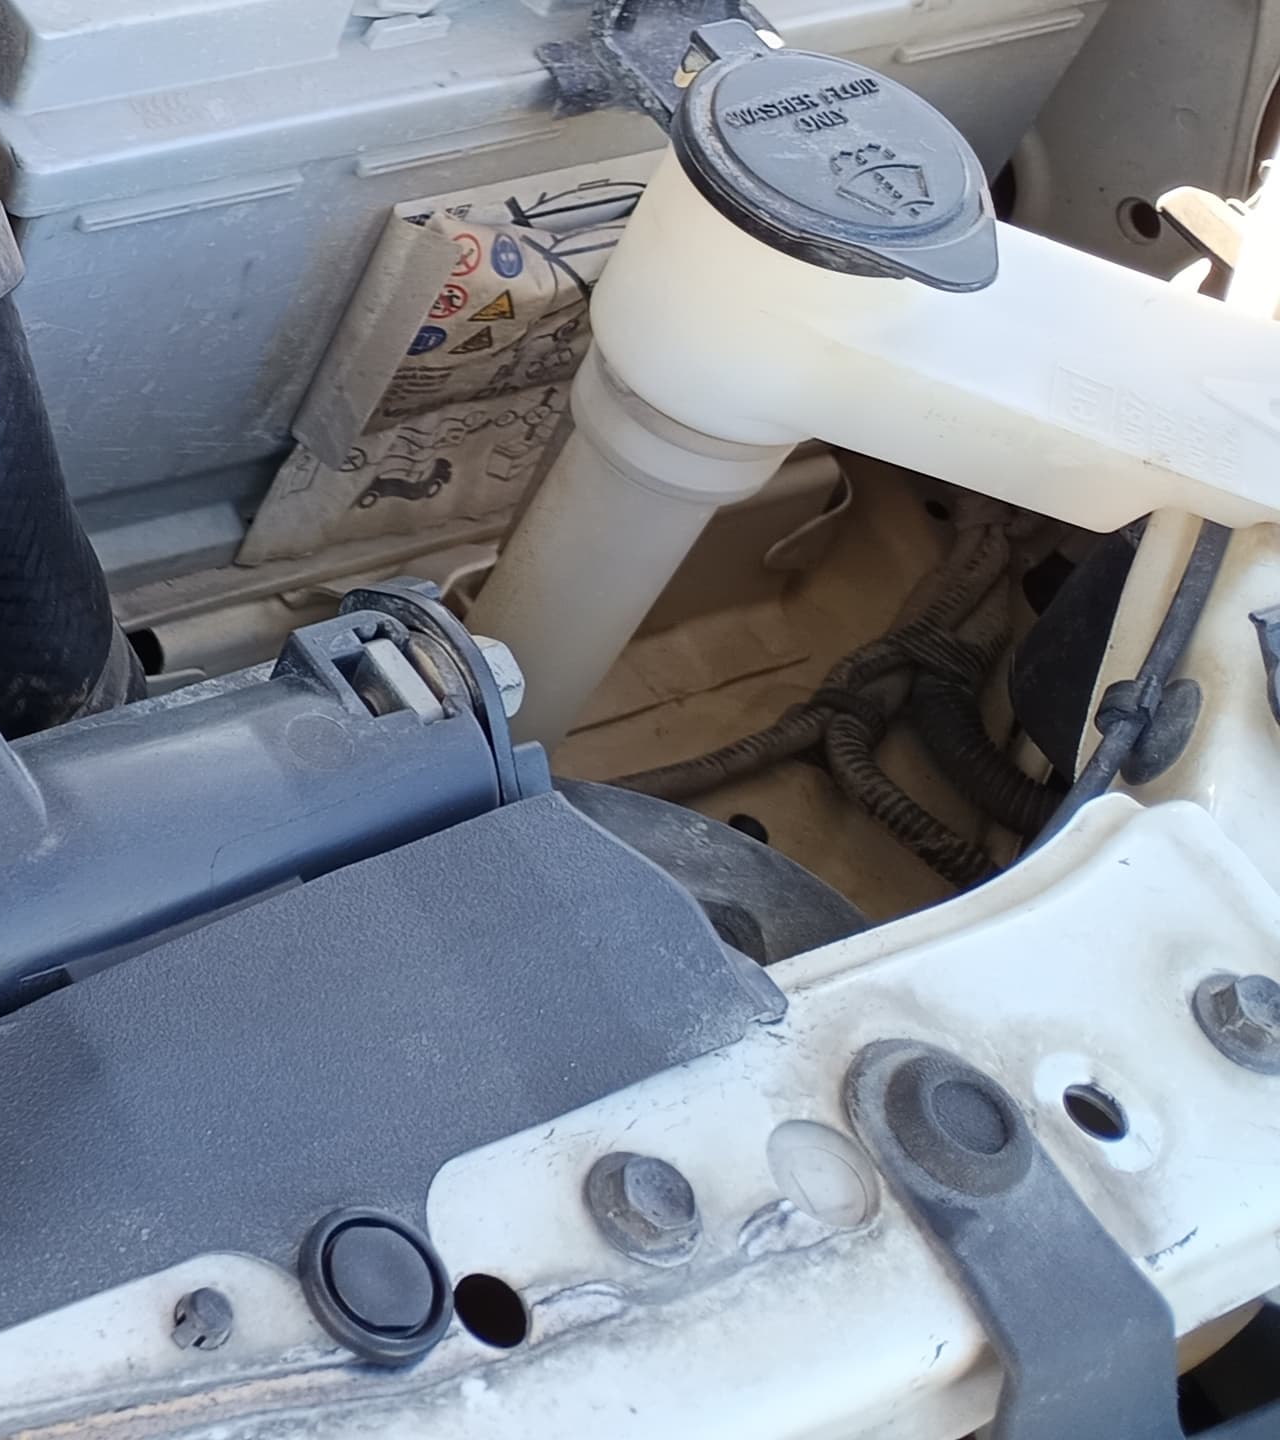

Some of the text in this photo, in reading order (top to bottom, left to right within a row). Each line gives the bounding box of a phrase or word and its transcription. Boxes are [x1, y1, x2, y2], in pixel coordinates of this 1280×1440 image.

[724, 78, 880, 127] WASHER FLUID
[796, 107, 850, 131] ONLY
